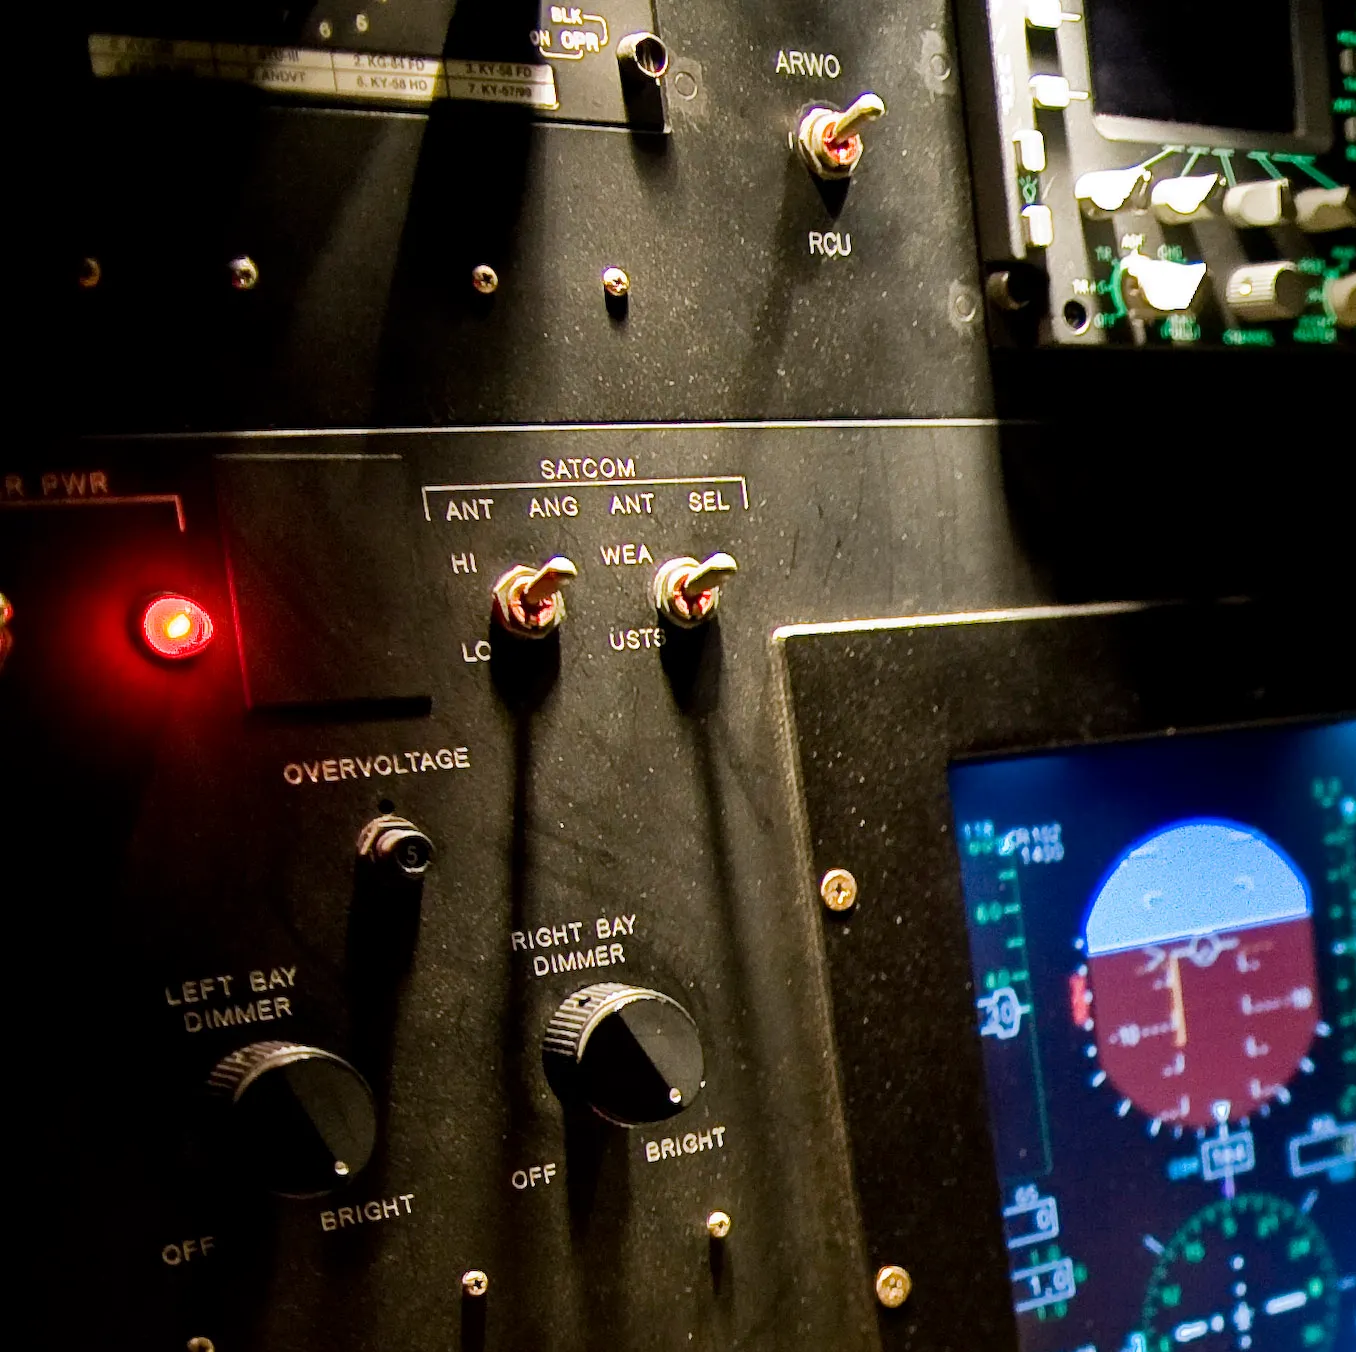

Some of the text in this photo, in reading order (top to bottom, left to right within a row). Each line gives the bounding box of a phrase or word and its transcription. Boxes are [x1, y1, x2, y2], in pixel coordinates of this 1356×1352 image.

[551, 6, 583, 25] BLK
[529, 29, 599, 52] ON OPR
[775, 50, 841, 79] ARWO
[808, 231, 852, 257] RCU
[41, 470, 109, 496] PWR
[540, 457, 637, 480] SATCOM
[446, 489, 731, 521] ANT ANG ANT SEL
[451, 543, 653, 574] HI WEA
[283, 746, 471, 786] OVERVOLTAGE
[406, 845, 419, 865] 5
[511, 913, 636, 951] RIGHT BAY
[533, 943, 626, 977] DIMMER
[165, 965, 296, 1006] LEFT BAY
[184, 996, 293, 1033] DIMMER
[511, 1126, 726, 1190] OFF BRIGHT
[161, 1193, 414, 1266] OFF BRIGHT
